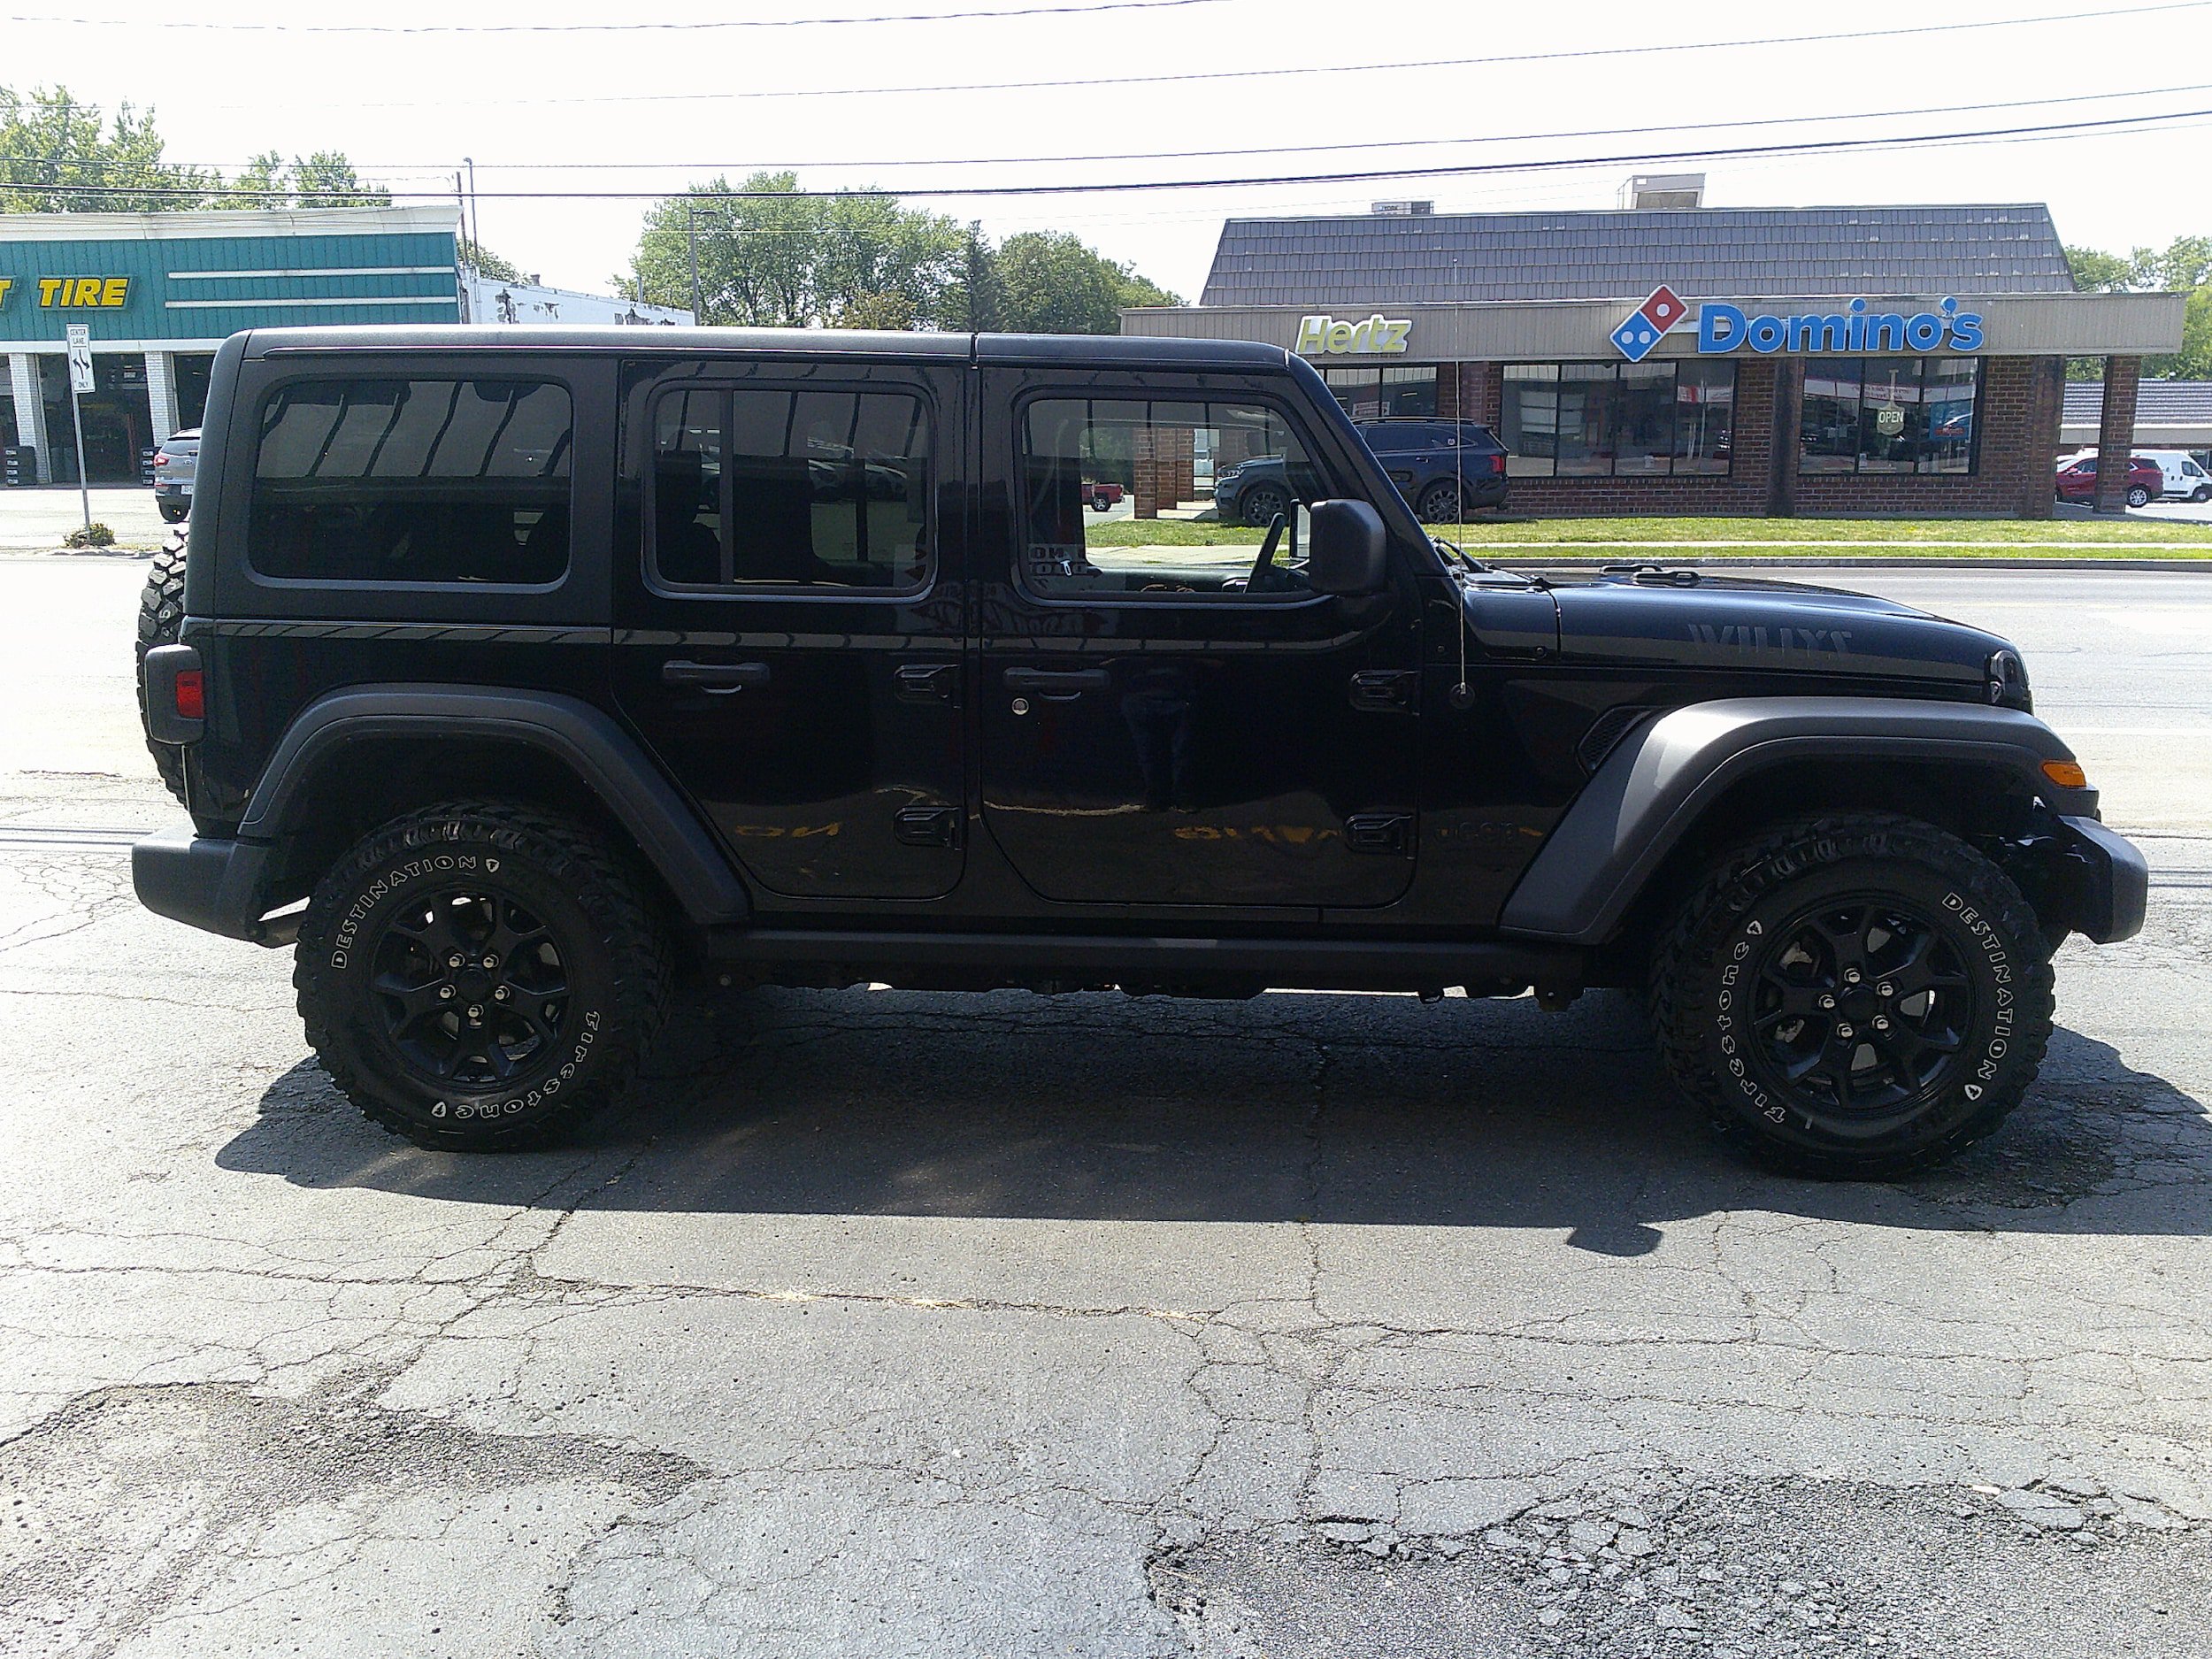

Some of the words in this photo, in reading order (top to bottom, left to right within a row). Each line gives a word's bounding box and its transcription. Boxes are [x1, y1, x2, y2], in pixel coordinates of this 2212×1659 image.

[39, 278, 128, 307] TIRE
[1297, 316, 1411, 353] Hertz
[1699, 296, 1985, 354] Domino's
[1878, 411, 1904, 424] OPEN
[1687, 623, 1854, 660] WILLYS
[330, 855, 478, 970] DESTINATION
[1941, 891, 2015, 1080] DESTINATION
[1717, 941, 1787, 1124] Firestone
[454, 1010, 601, 1119] Firestone
